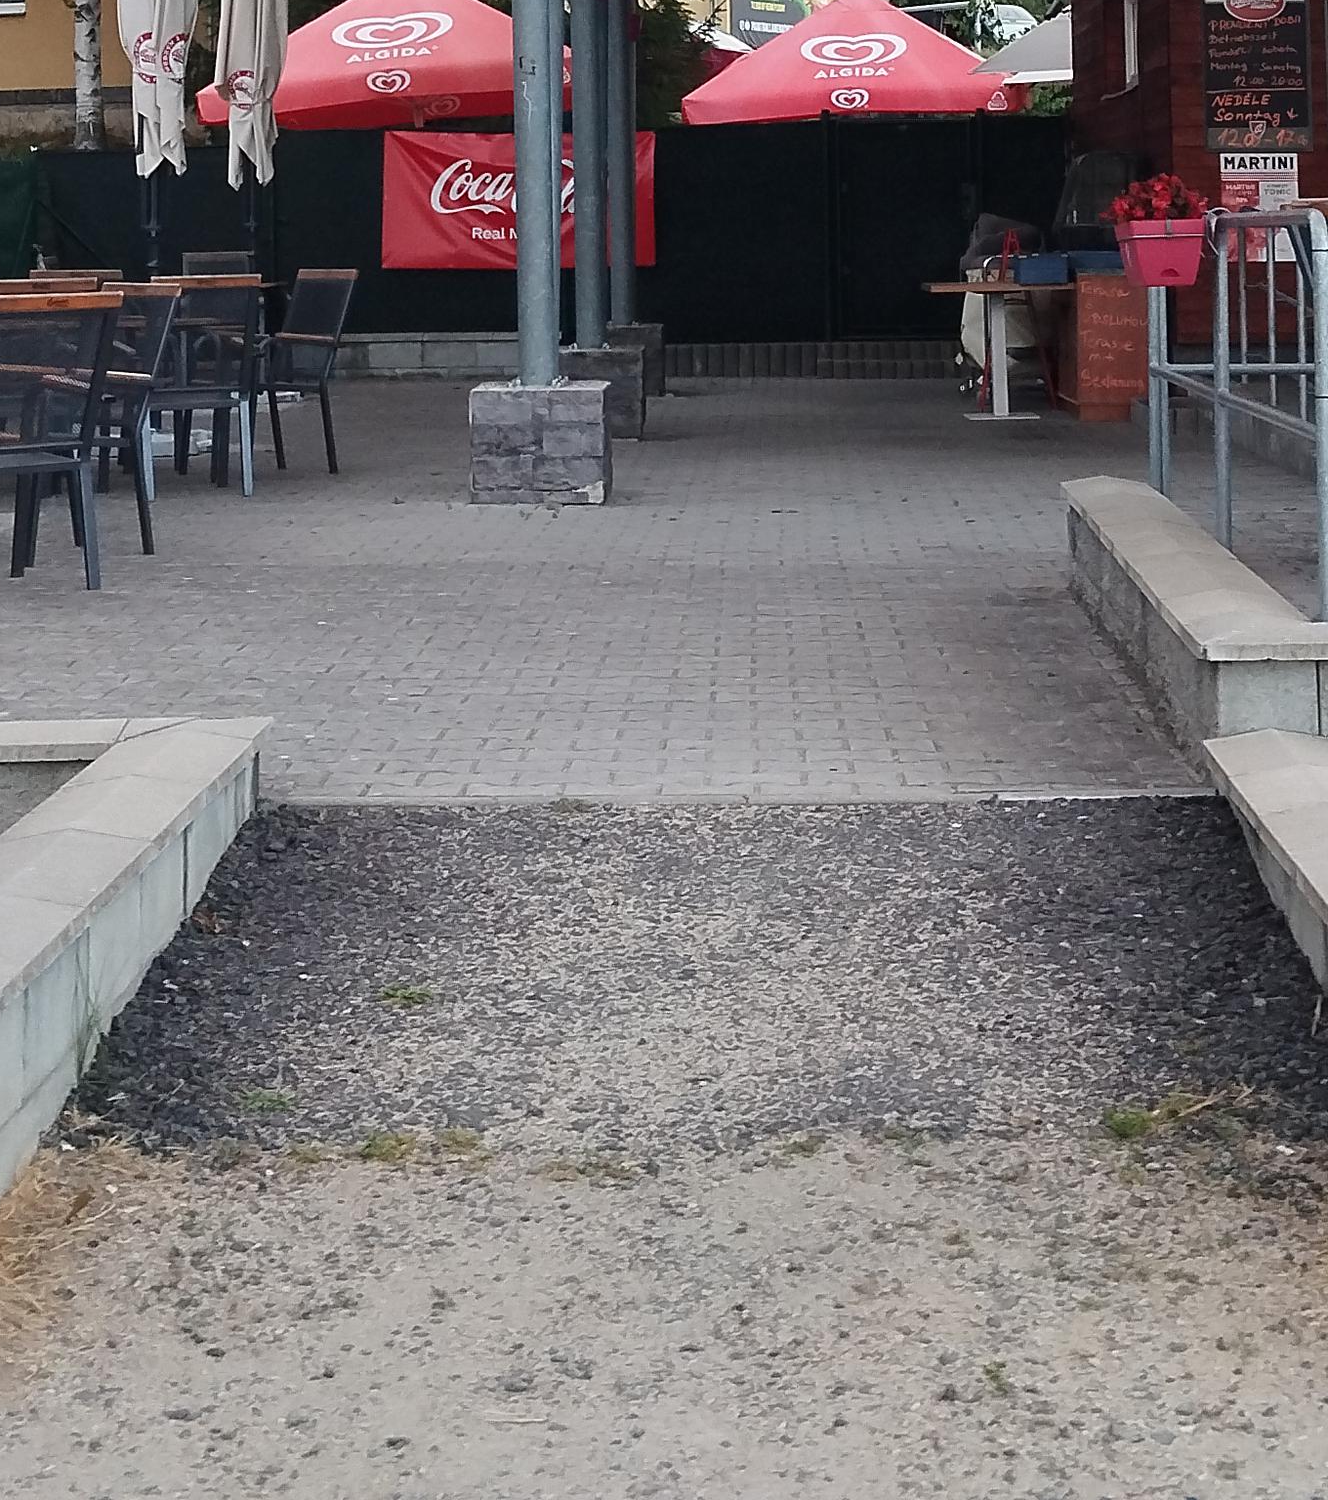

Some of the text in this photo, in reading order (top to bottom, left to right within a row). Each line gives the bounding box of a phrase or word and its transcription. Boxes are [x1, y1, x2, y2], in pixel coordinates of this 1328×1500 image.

[346, 47, 433, 64] ALGIDA
[814, 67, 889, 79] ALGIDA
[1214, 108, 1281, 127] Sonntag
[1224, 156, 1294, 170] MARTINI
[471, 227, 506, 241] Real
